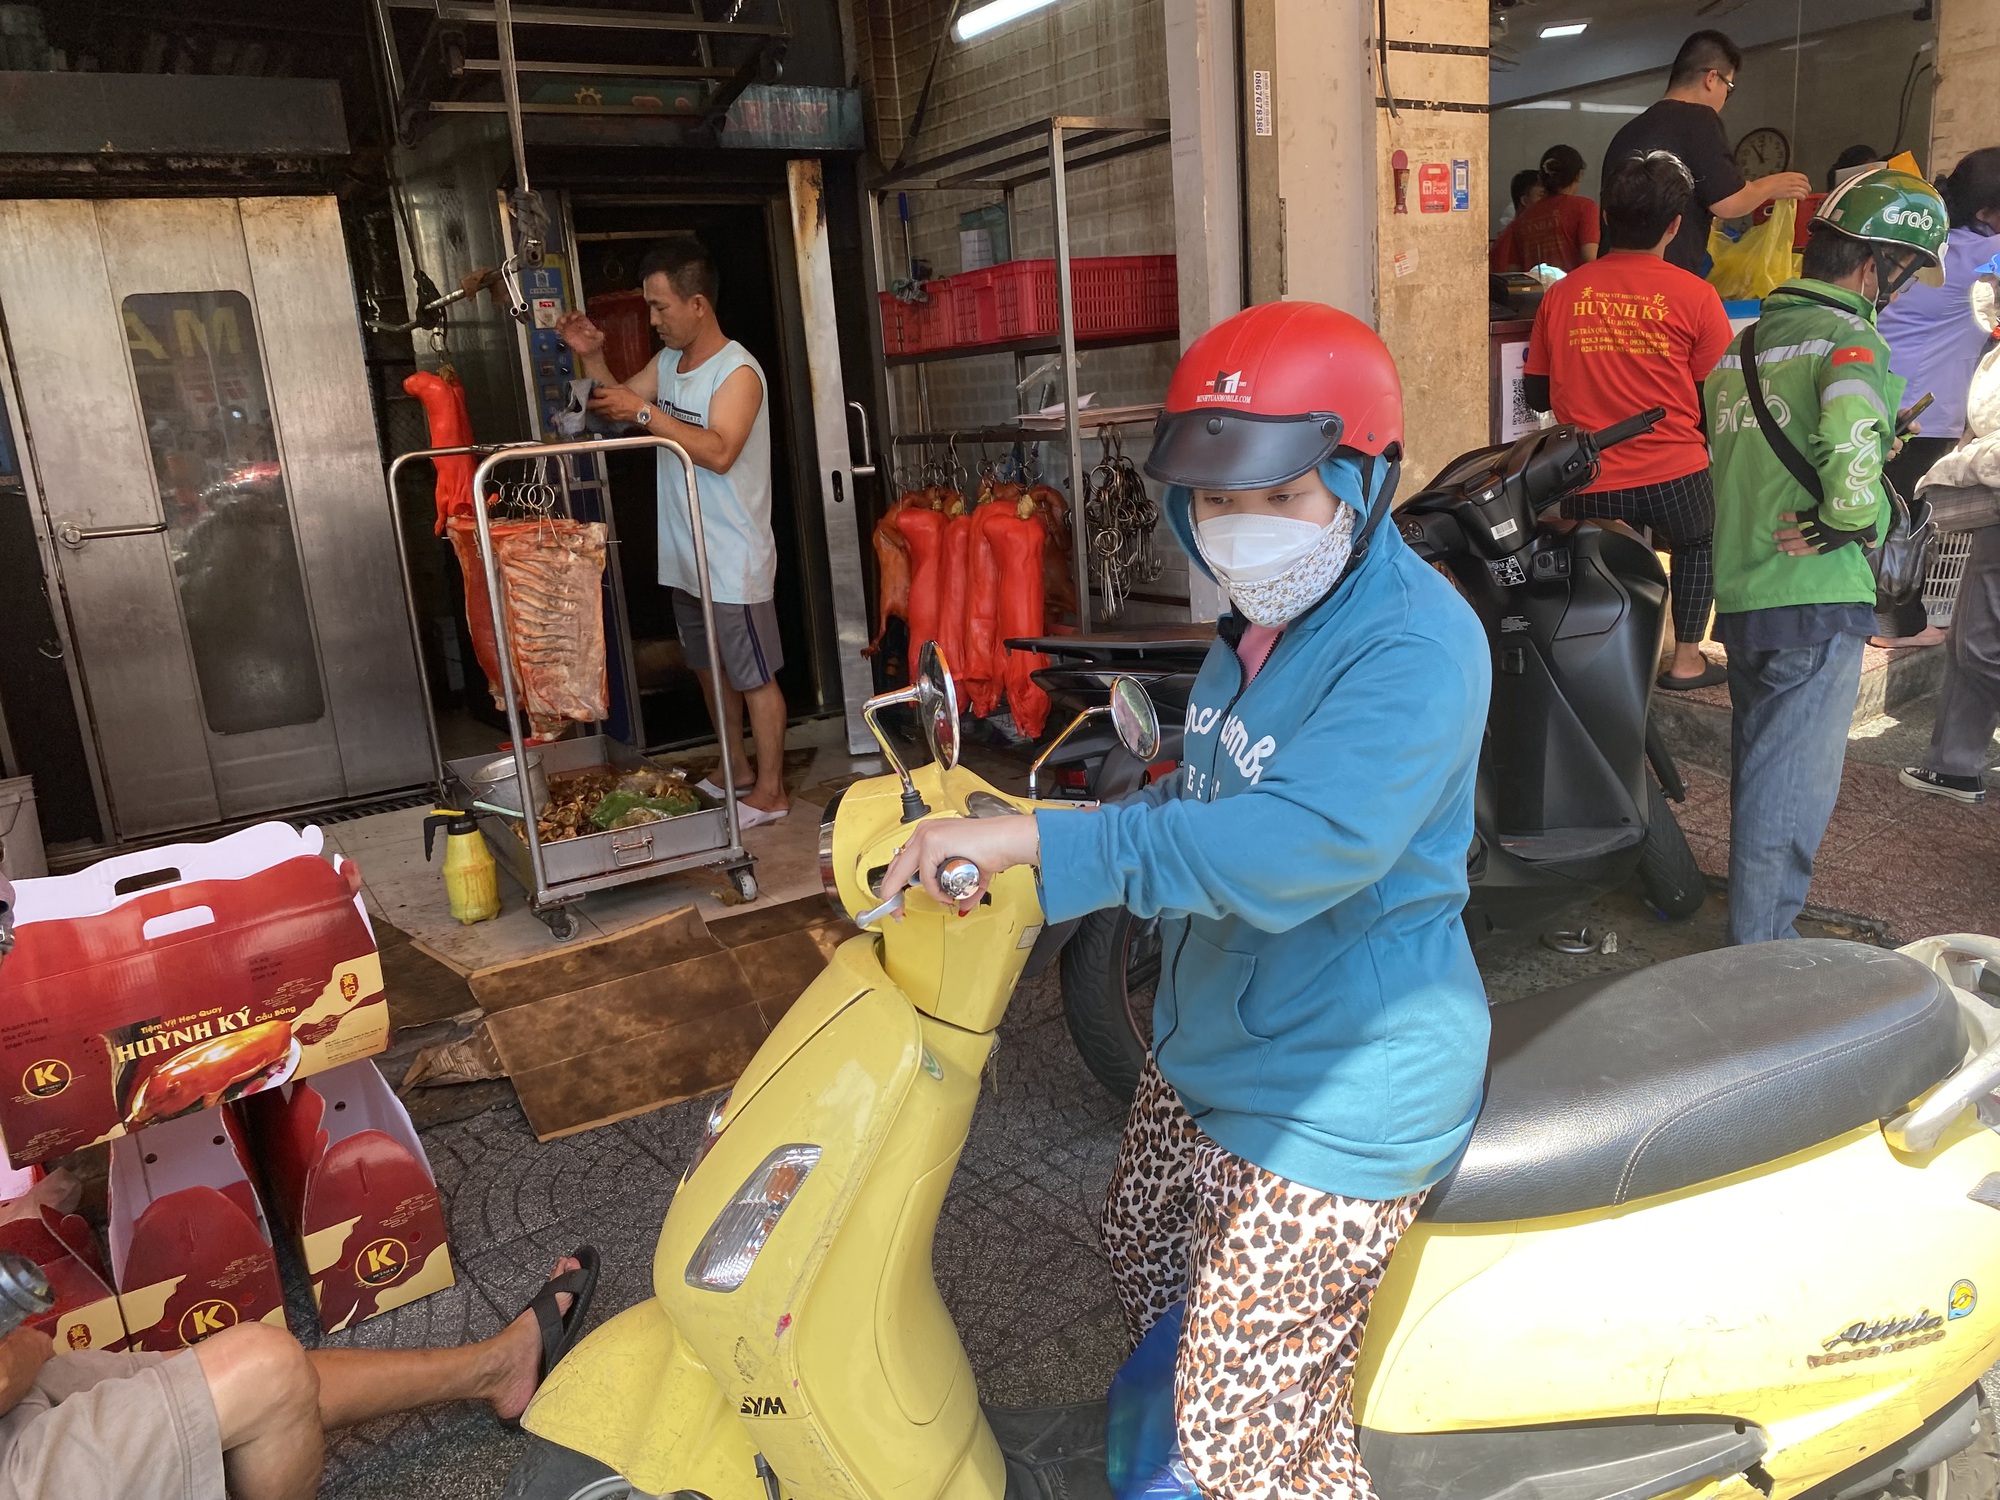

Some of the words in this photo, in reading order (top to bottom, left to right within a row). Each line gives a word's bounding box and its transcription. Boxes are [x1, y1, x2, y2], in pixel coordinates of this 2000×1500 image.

[1432, 186, 1448, 195] Food
[1883, 206, 1933, 231] Grab
[1573, 298, 1638, 318] HUỲNH
[1641, 306, 1669, 321] KÝ
[1716, 379, 1791, 434] Grab
[117, 1020, 213, 1063] HUỲNH
[217, 1005, 251, 1034] KÝ
[255, 1012, 273, 1023] Cầu
[274, 1005, 297, 1018] Bông
[140, 1019, 163, 1035] Tiệm
[165, 1015, 177, 1028] Vịt
[178, 1012, 198, 1024] Heo
[198, 1006, 223, 1018] Quay
[33, 1062, 62, 1087] K
[367, 1242, 397, 1273] K
[193, 1304, 225, 1335] K
[1821, 1308, 1945, 1351] Attila
[741, 1397, 787, 1416] SYM
